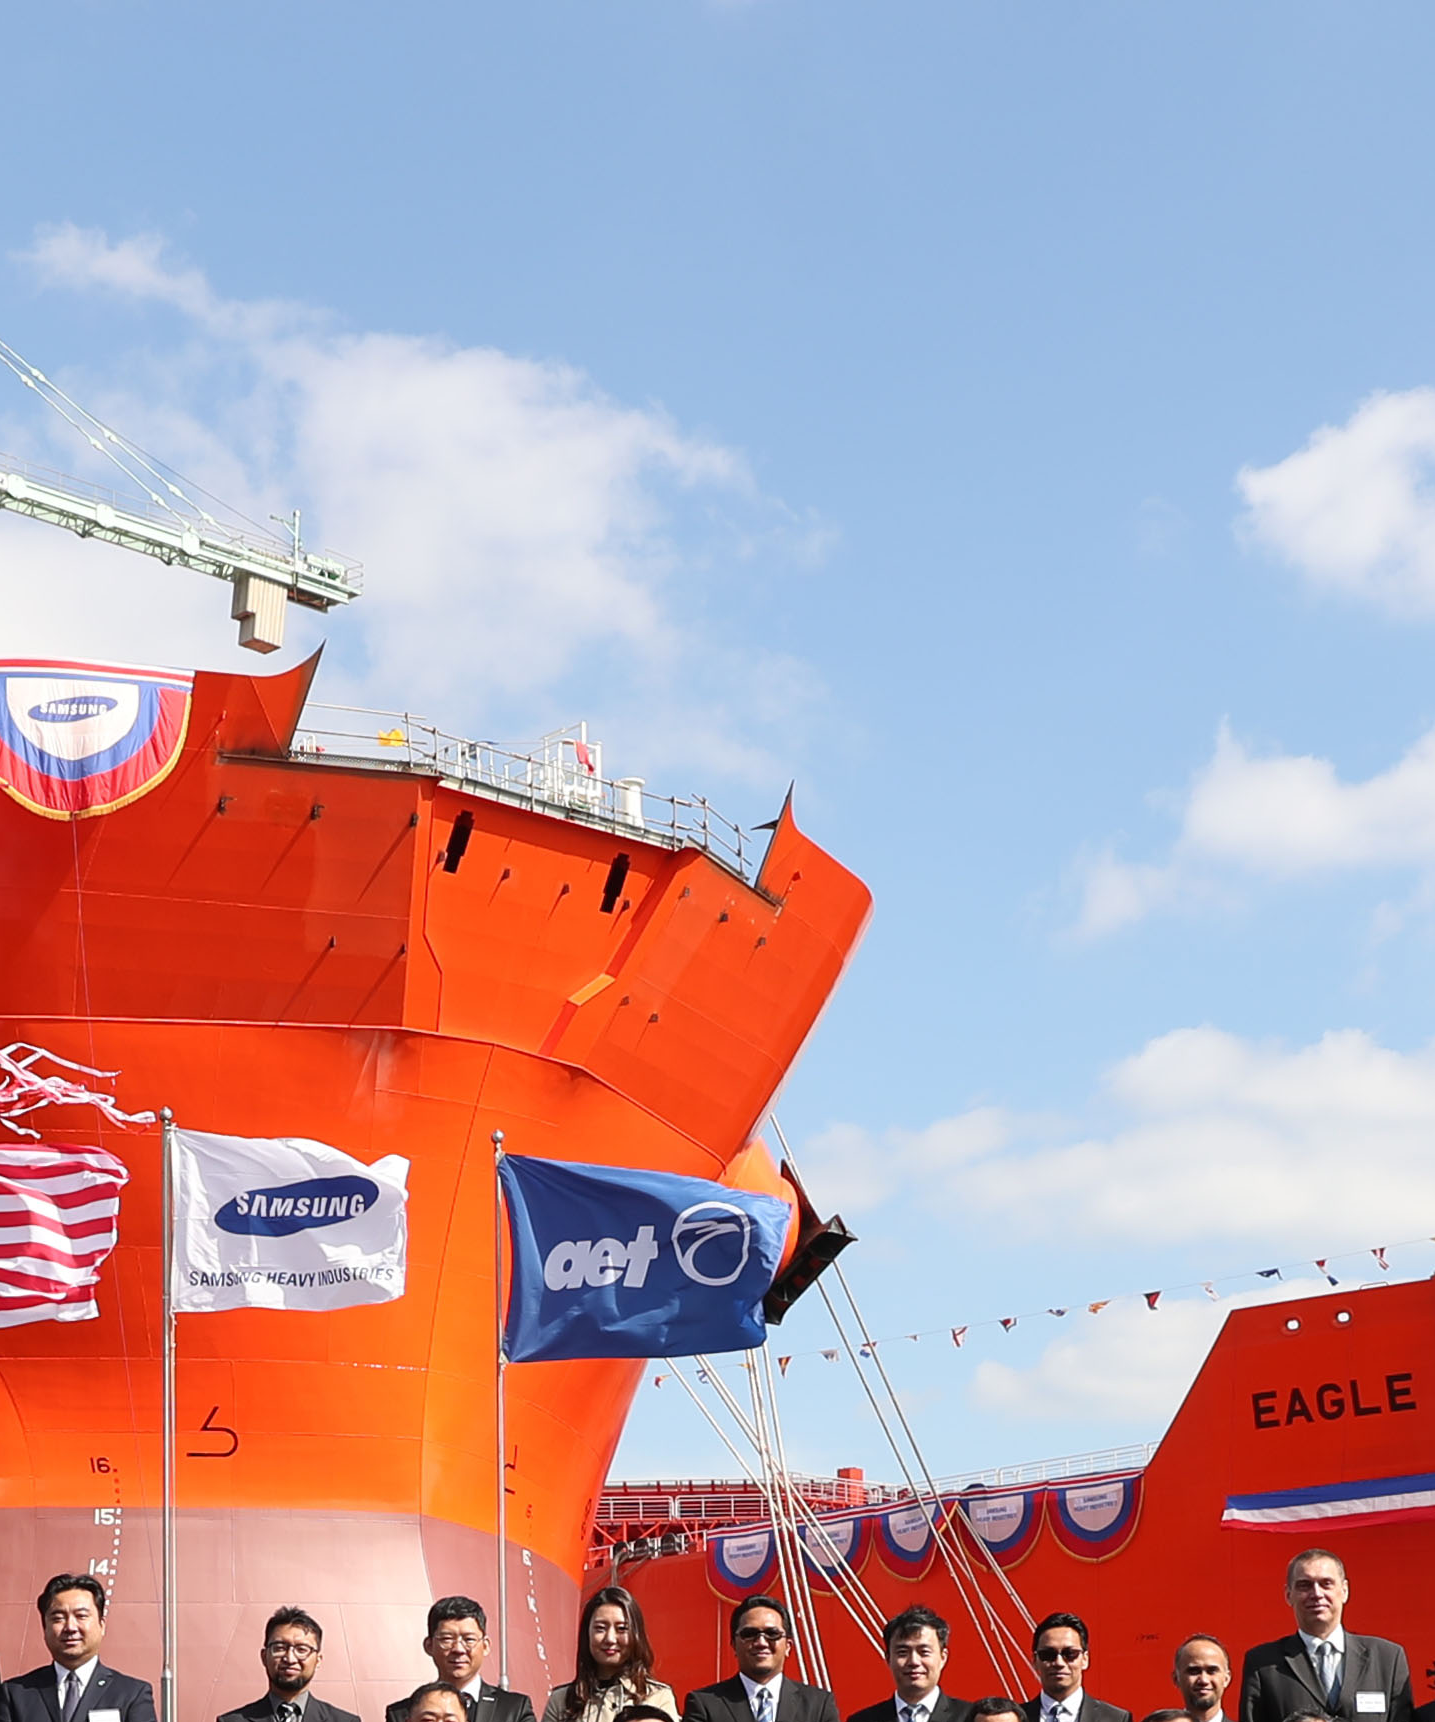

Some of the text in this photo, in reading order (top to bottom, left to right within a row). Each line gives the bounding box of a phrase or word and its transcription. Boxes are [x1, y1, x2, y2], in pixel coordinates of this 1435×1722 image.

[40, 703, 108, 716] SAMSUNG
[236, 1192, 366, 1218] SAMSUNG
[544, 1225, 659, 1291] aet
[189, 1267, 395, 1288] SAMSUNG HEAVY INDUSTRIES
[1252, 1372, 1417, 1429] EAGLE
[90, 1456, 111, 1474] 16
[94, 1508, 115, 1525] 15
[89, 1558, 109, 1576] 14
